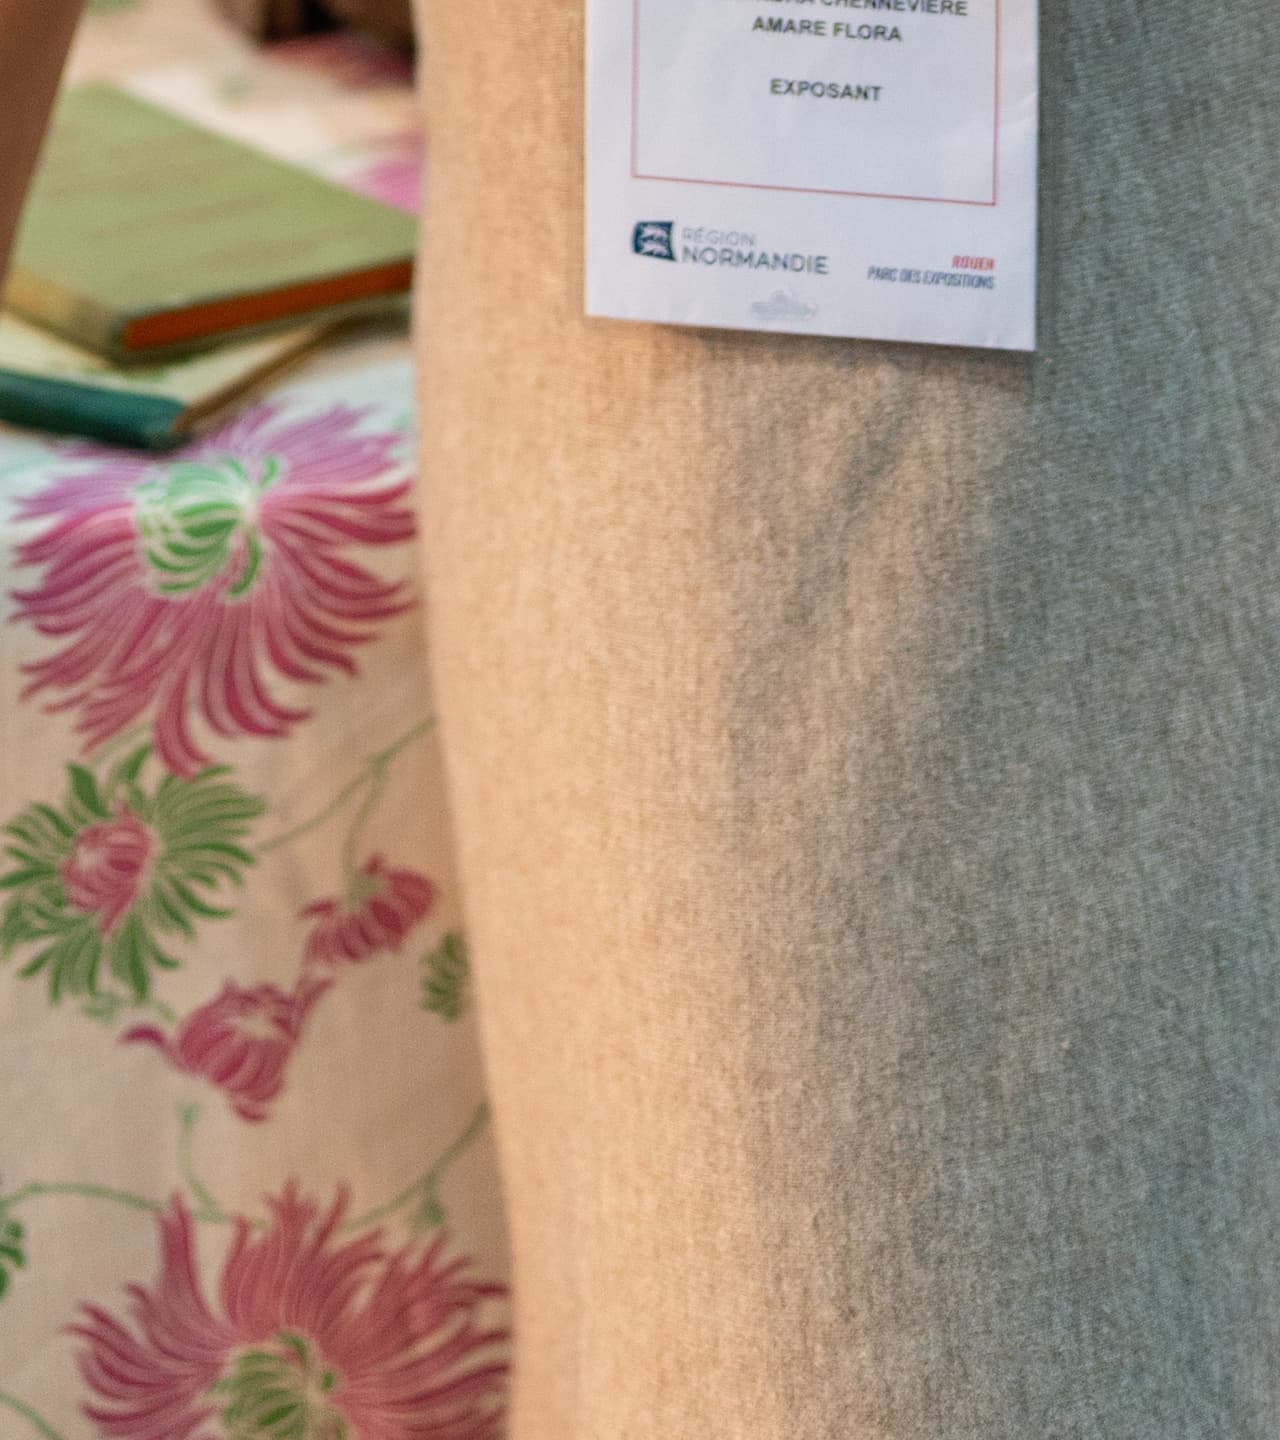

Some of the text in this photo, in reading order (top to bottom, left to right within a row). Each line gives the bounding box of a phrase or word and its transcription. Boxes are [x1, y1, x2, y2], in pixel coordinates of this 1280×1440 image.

[752, 16, 903, 41] AMARE FLORA
[770, 78, 883, 101] EXPOSANT
[682, 227, 756, 247] RÉGION
[683, 246, 830, 275] NORMANDIE
